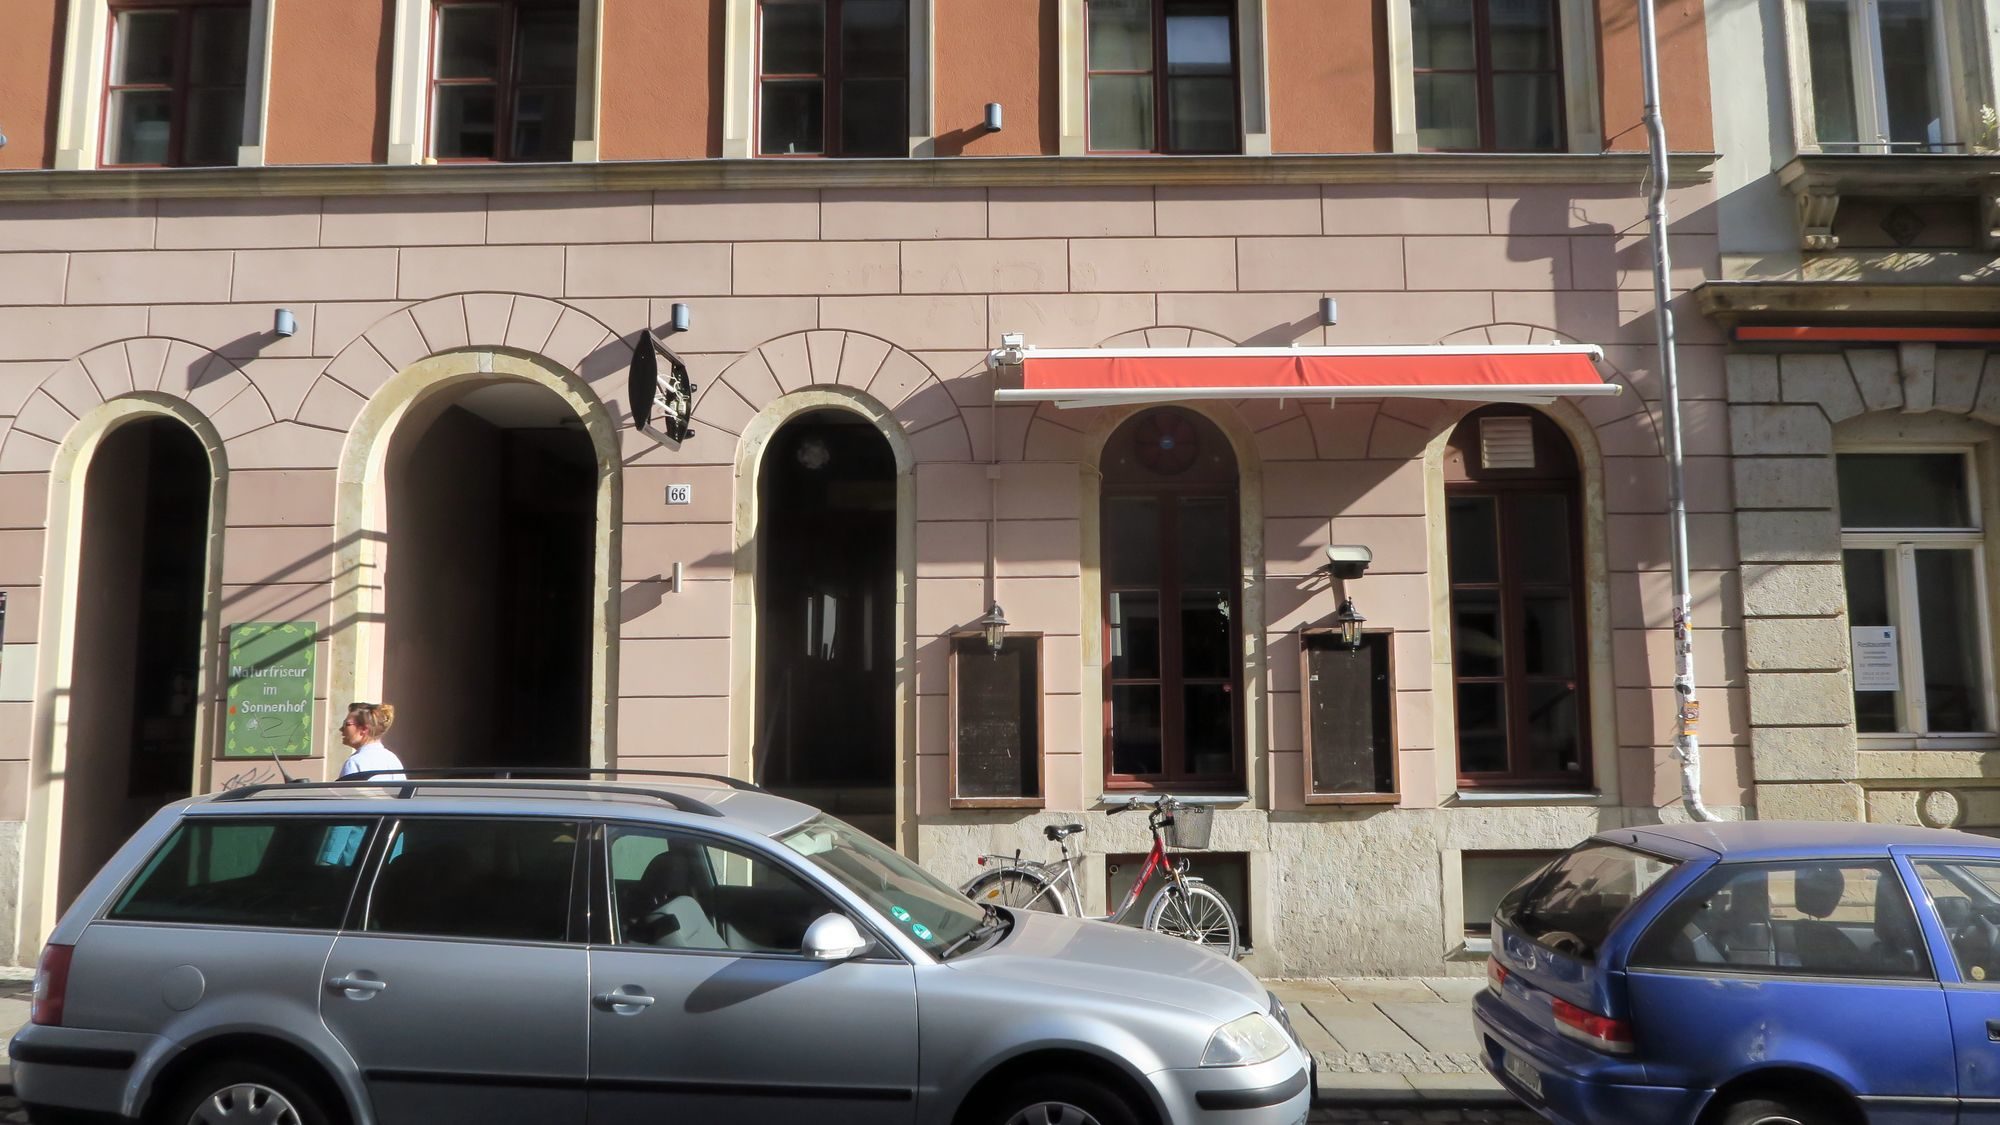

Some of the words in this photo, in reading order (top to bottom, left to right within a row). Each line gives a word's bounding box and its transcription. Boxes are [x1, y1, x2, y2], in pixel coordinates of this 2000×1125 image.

[671, 487, 686, 501] 66
[231, 664, 307, 678] Naturfriseur
[263, 682, 277, 695] im
[241, 699, 307, 714] Sonnenhof
